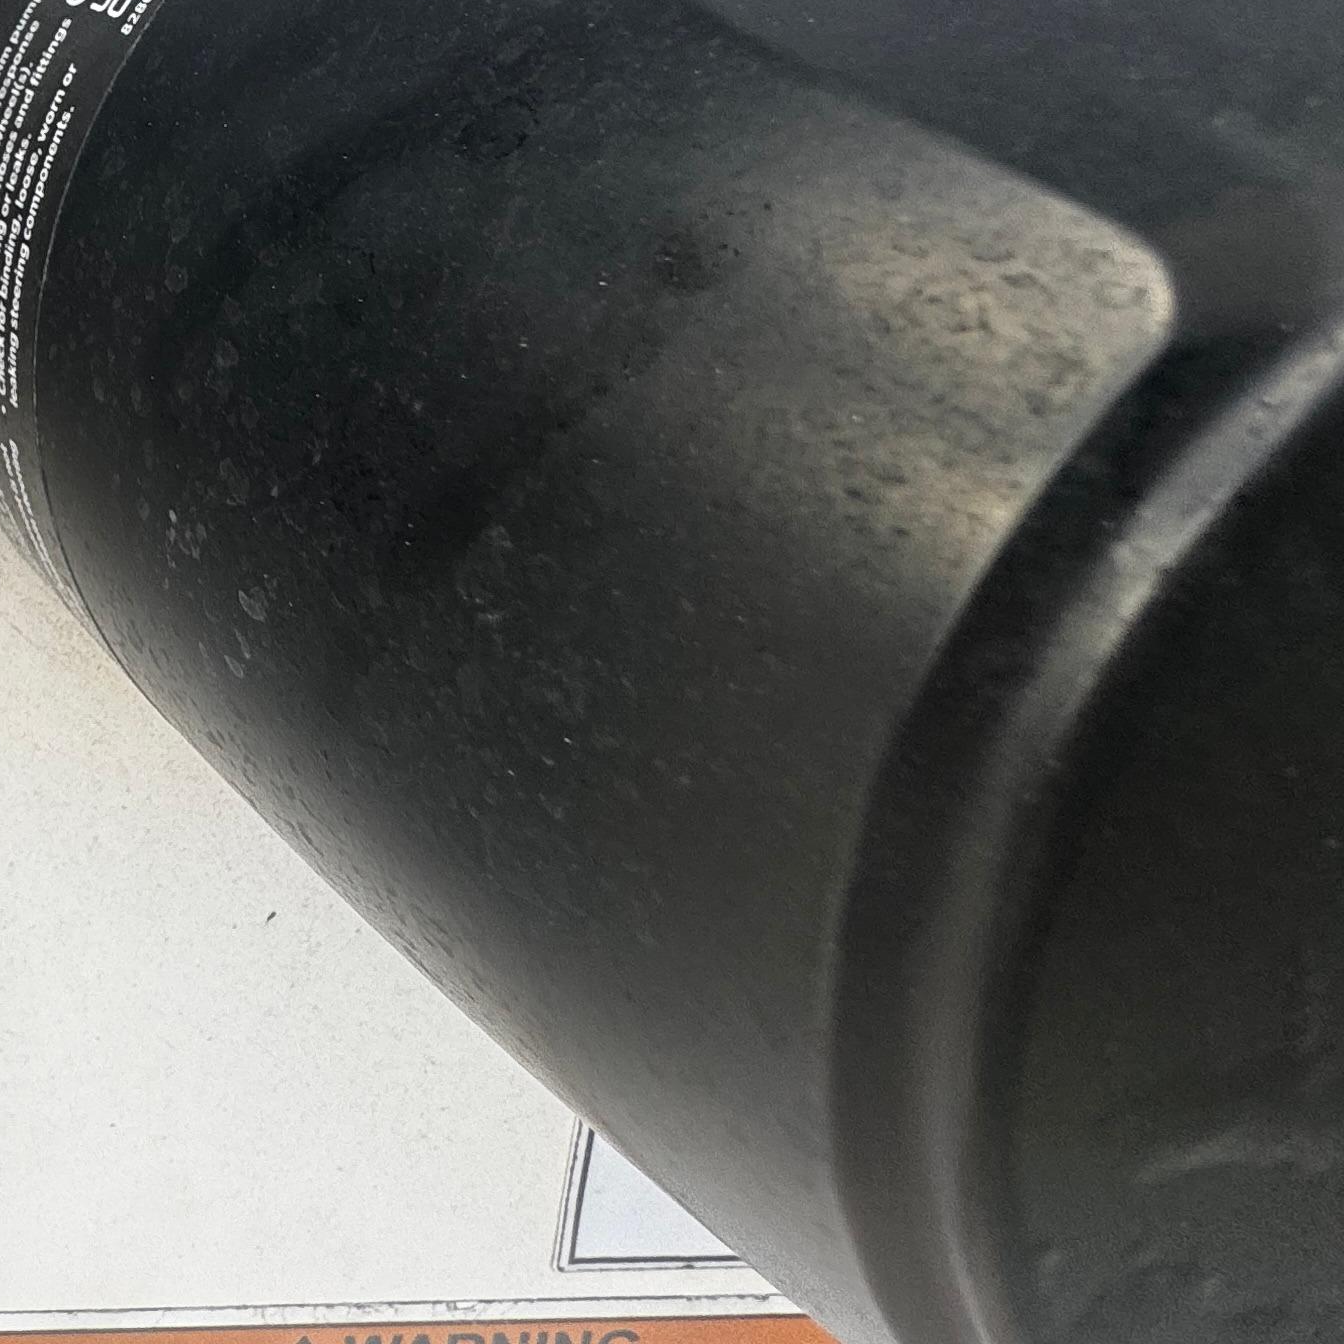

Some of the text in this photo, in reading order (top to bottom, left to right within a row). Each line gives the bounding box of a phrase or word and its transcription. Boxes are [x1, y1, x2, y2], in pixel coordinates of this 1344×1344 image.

[14, 88, 34, 128] and
[30, 18, 72, 87] fittings
[0, 214, 23, 299] binding,
[15, 148, 42, 209] loose,
[37, 89, 65, 141] worn
[63, 63, 77, 87] or
[1, 196, 11, 217] or
[6, 133, 32, 191] leaks.
[8, 107, 75, 408] leaking steering components.
